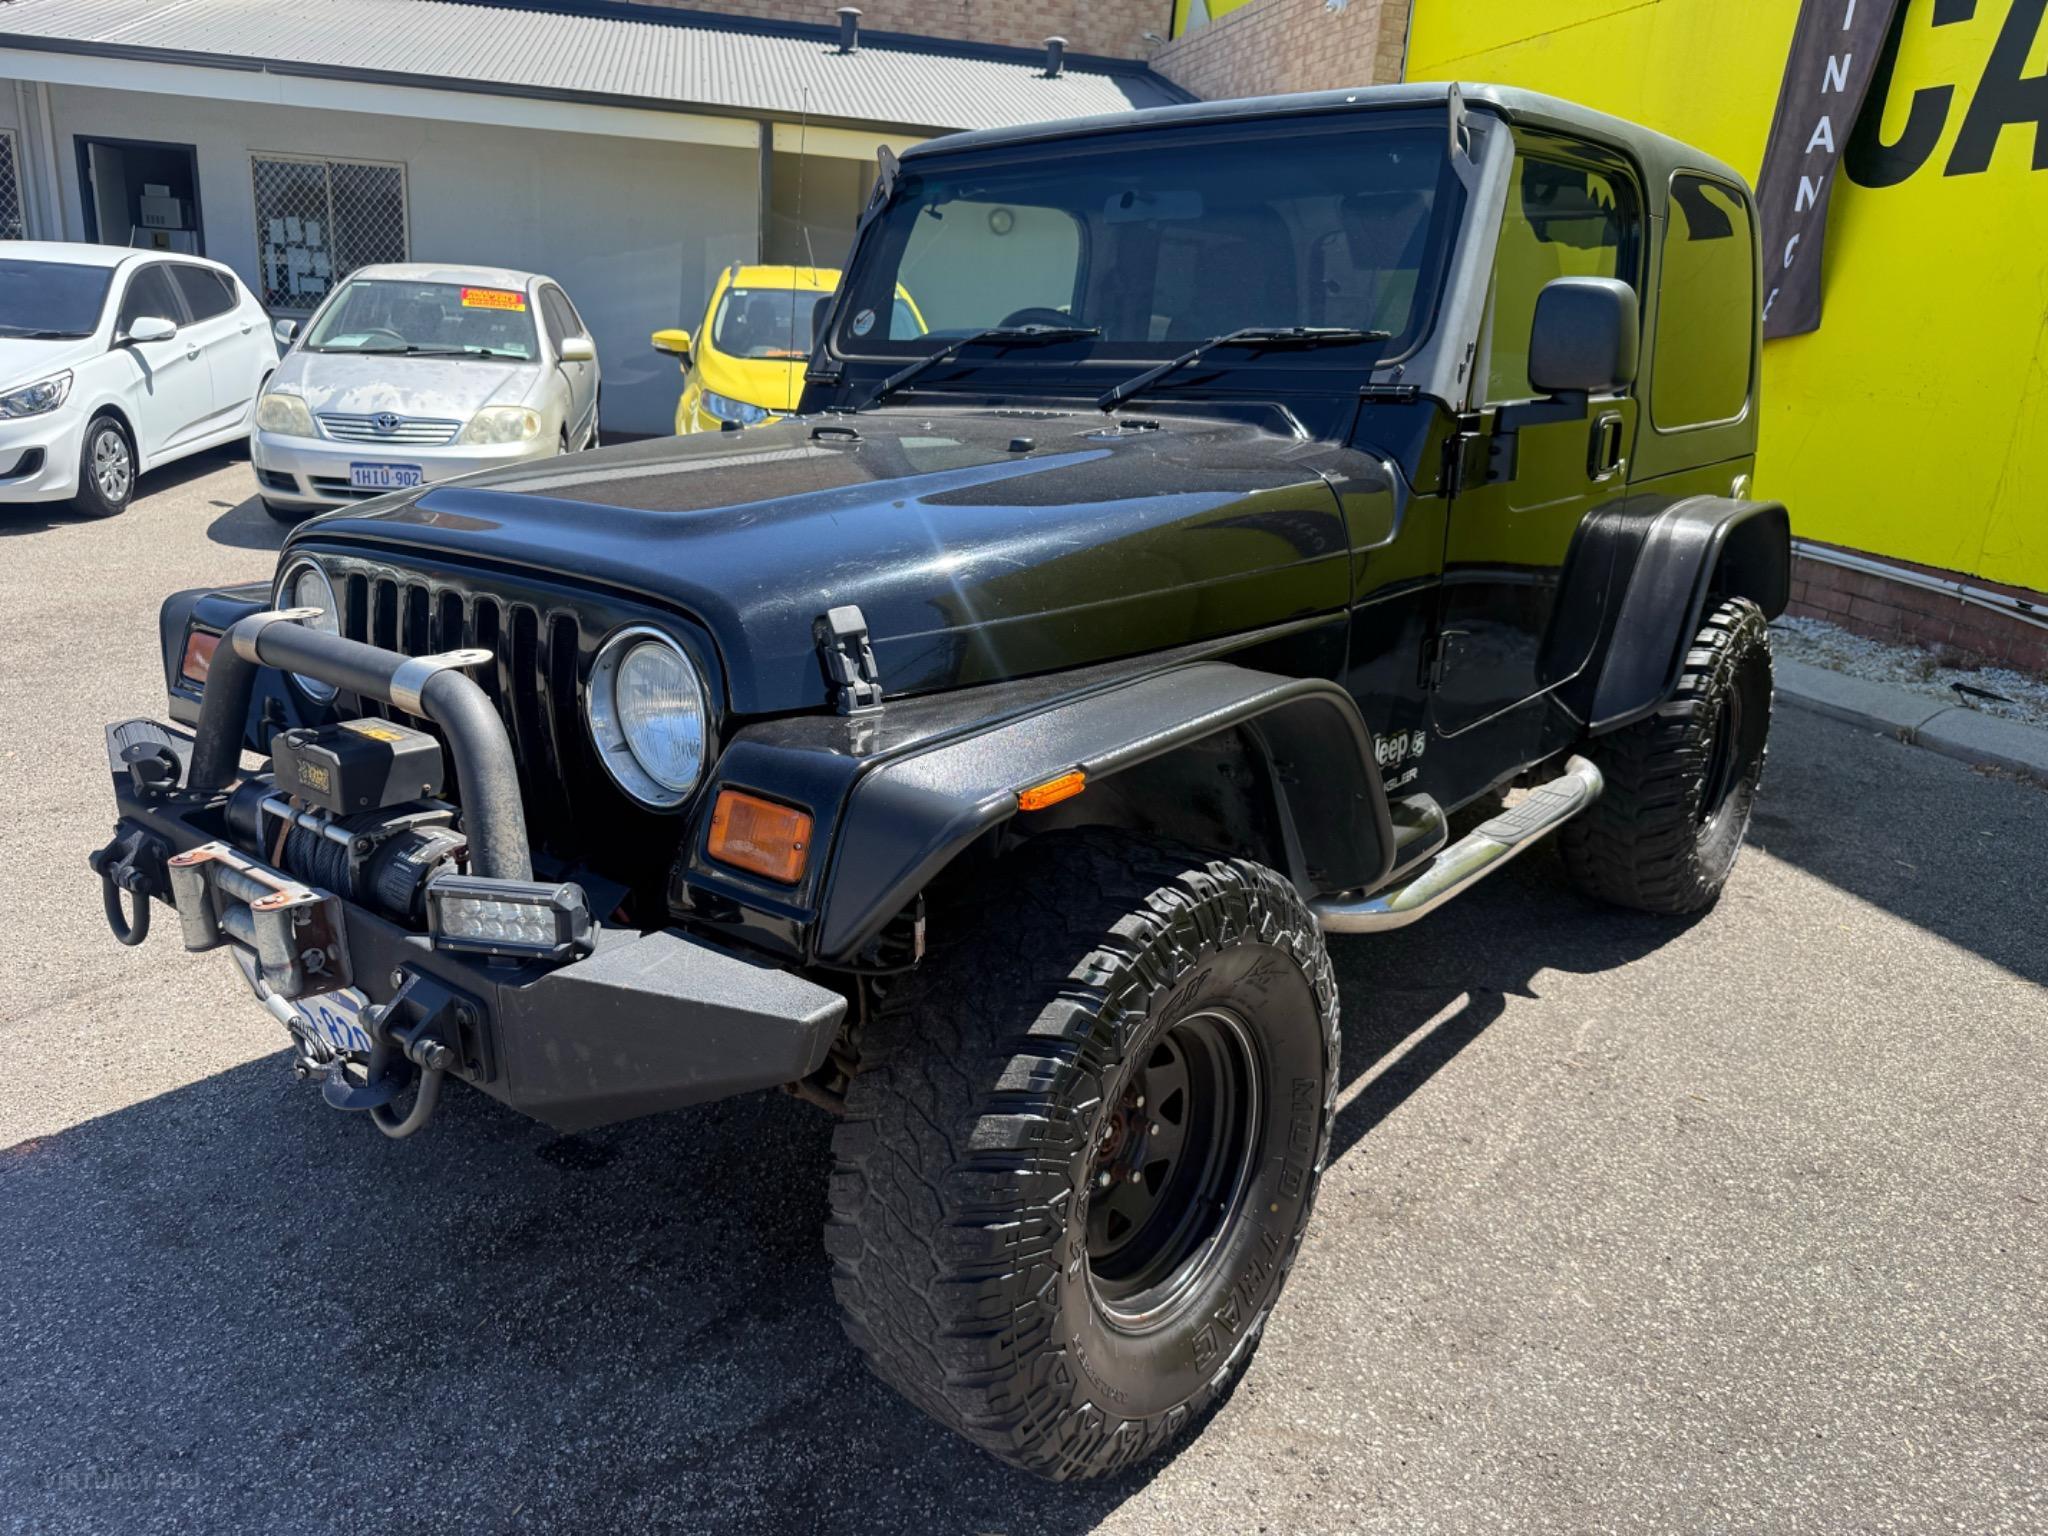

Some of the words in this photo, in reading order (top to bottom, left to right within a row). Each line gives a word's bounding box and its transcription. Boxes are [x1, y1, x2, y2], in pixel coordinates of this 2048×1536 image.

[395, 472, 419, 486] 902
[1374, 733, 1408, 765] Jeep
[1278, 1077, 1318, 1198] MUD
